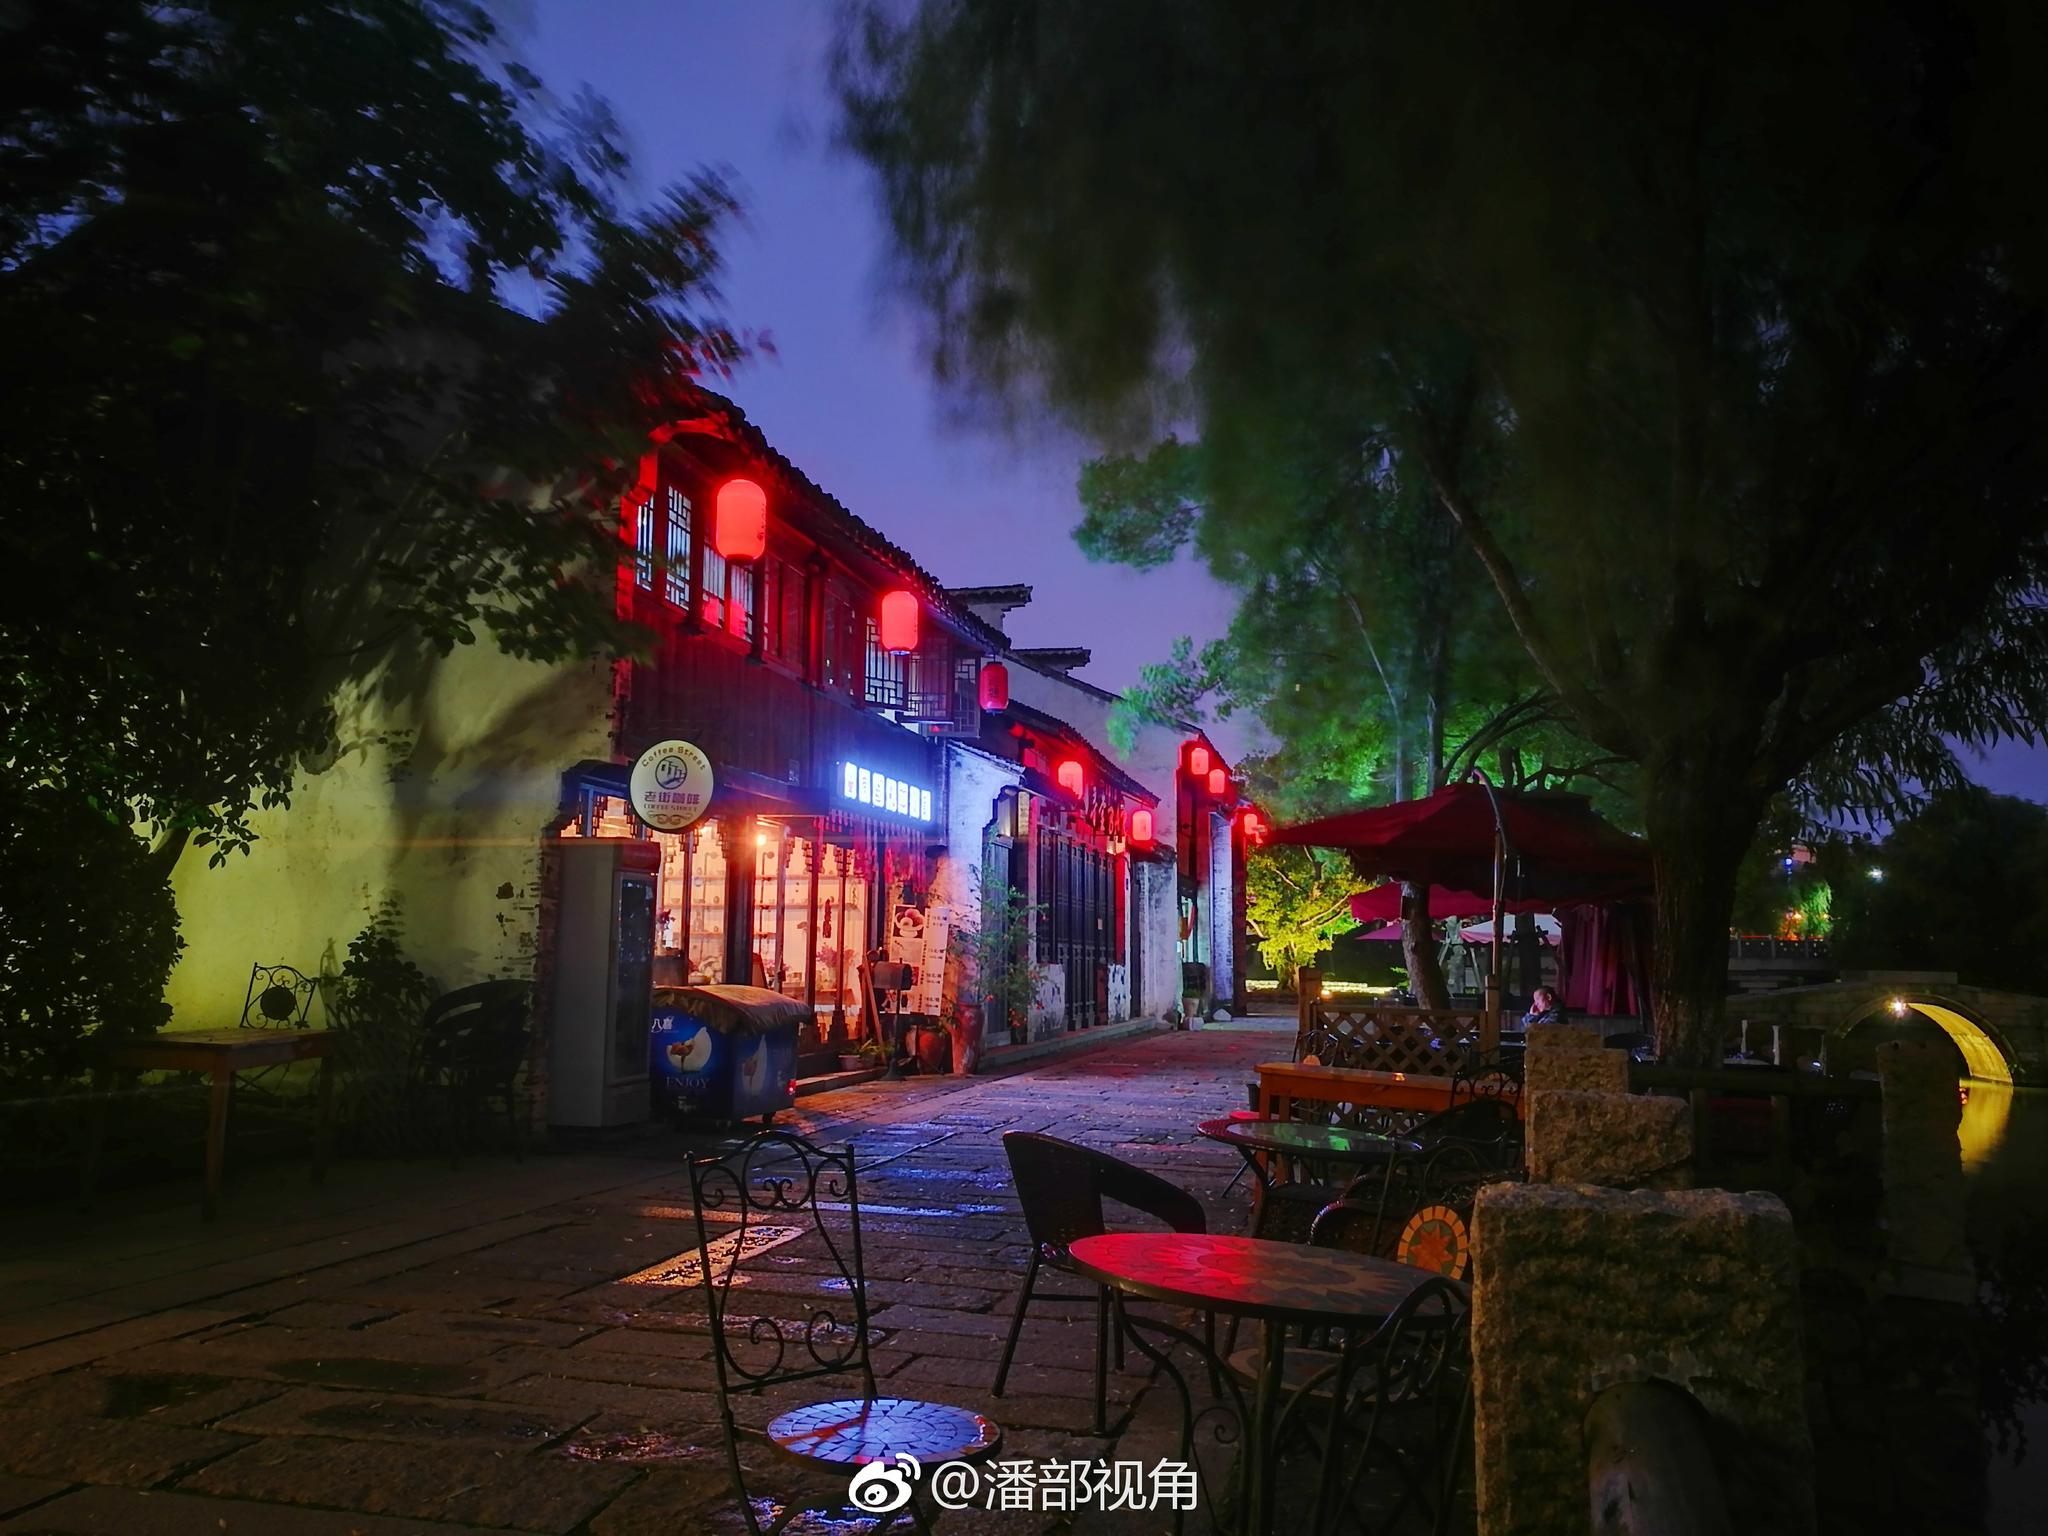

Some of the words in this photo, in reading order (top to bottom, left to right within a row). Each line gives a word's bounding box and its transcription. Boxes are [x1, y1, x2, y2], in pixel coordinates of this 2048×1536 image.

[641, 747, 674, 767] Coffee
[677, 746, 706, 770] Street
[651, 1016, 674, 1033] 八喜
[665, 1076, 710, 1089] ENJOY
